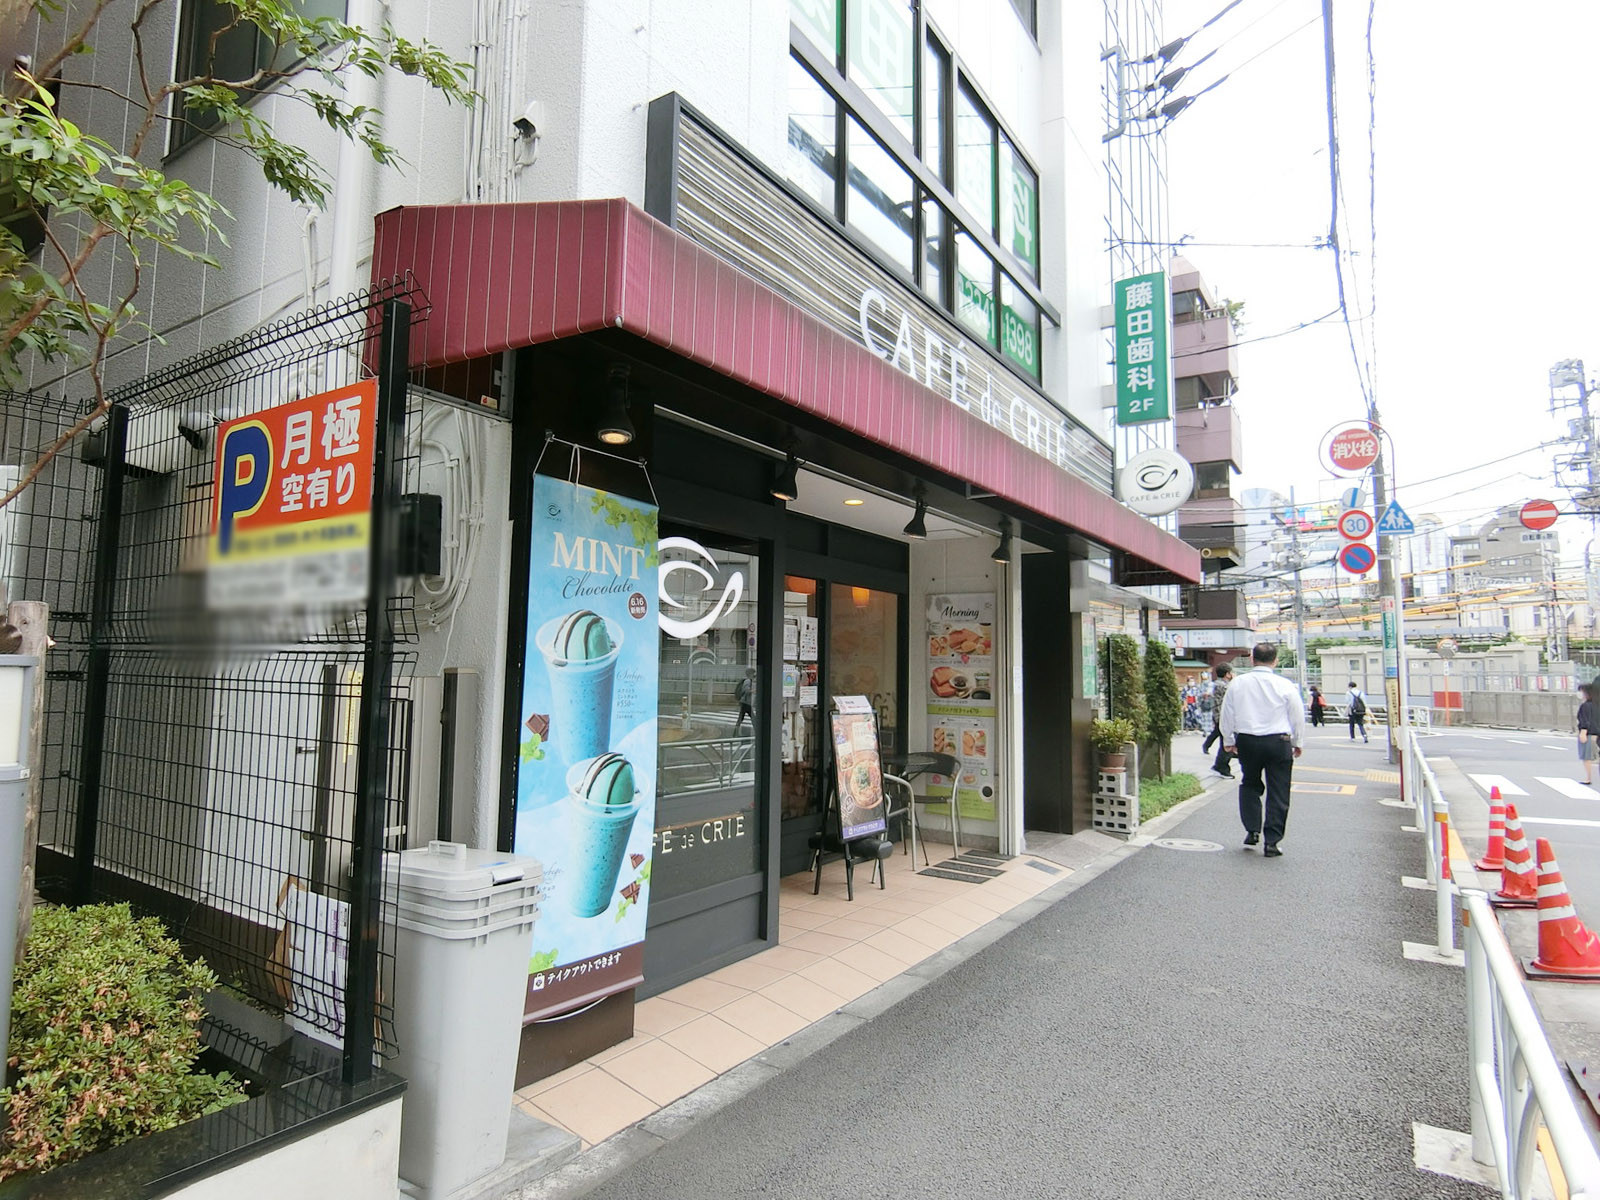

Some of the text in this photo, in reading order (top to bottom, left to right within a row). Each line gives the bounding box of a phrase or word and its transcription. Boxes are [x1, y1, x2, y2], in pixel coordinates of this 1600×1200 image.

[1005, 311, 1033, 366] 1398
[1125, 281, 1156, 393] 藤田歯科
[980, 371, 1002, 428] de
[1129, 397, 1155, 414] 2F
[280, 395, 362, 469] 月極
[1332, 438, 1376, 460] 消火栓
[217, 419, 274, 554] P
[280, 462, 355, 513] 空有り
[1345, 518, 1367, 533] 30
[551, 531, 645, 580] MINT
[562, 570, 634, 600] Chocolate
[941, 606, 980, 620] Morning
[547, 951, 622, 985] テイクアウトできます
